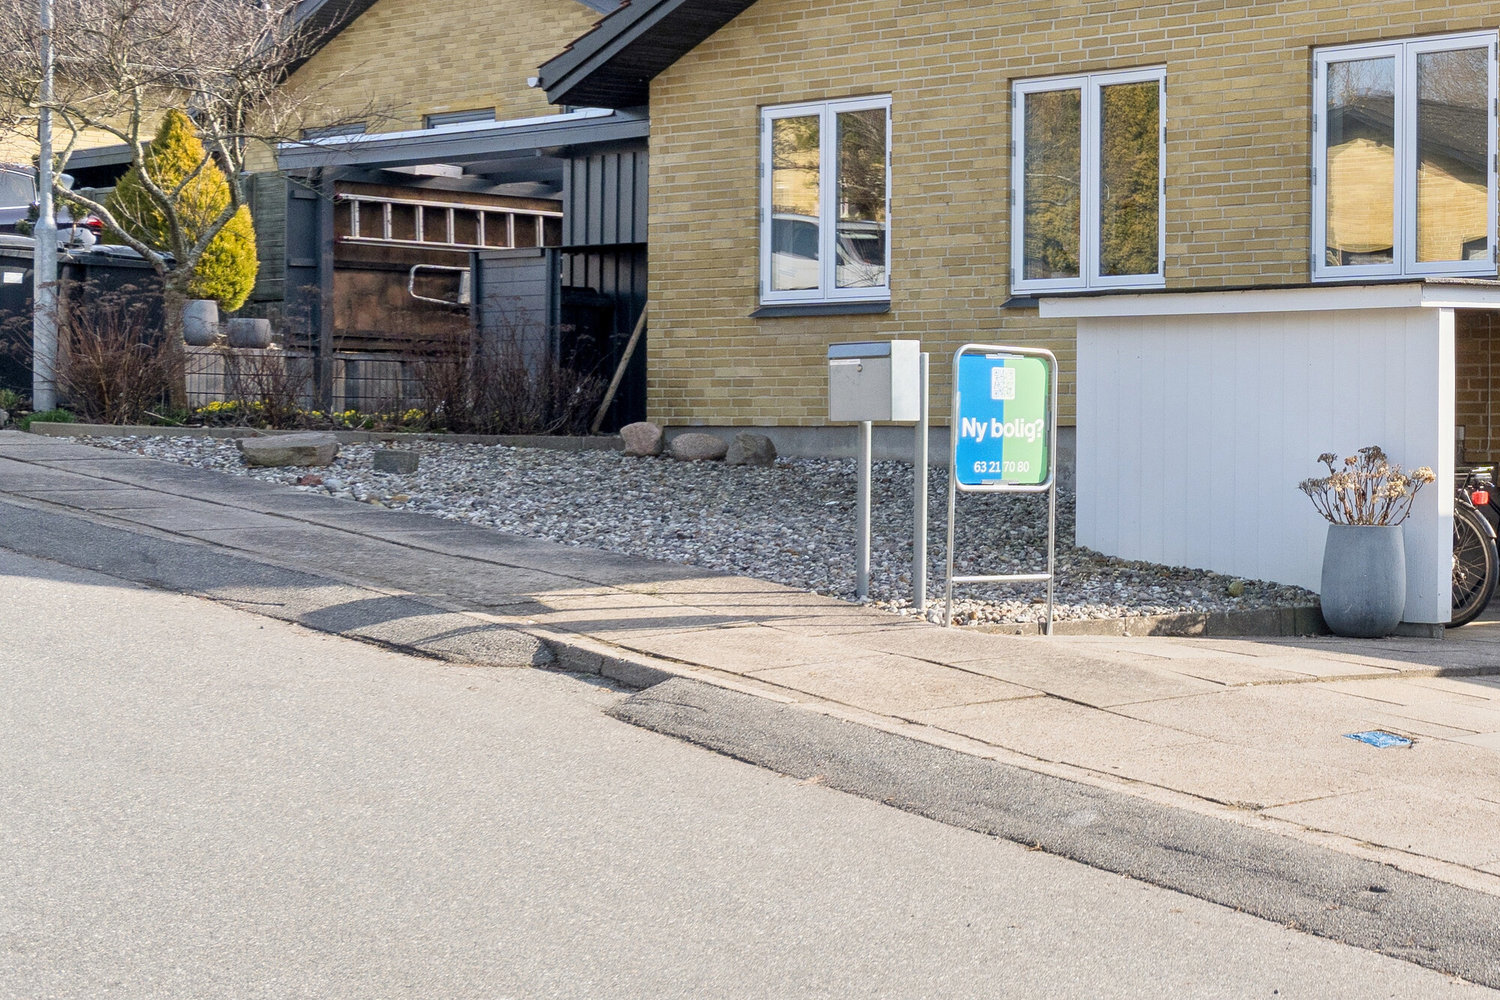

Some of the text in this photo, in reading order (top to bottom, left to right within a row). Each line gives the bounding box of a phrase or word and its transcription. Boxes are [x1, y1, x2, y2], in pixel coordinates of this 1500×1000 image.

[961, 417, 1044, 443] Ny bolig?
[974, 461, 1030, 473] 63 21 70 80
